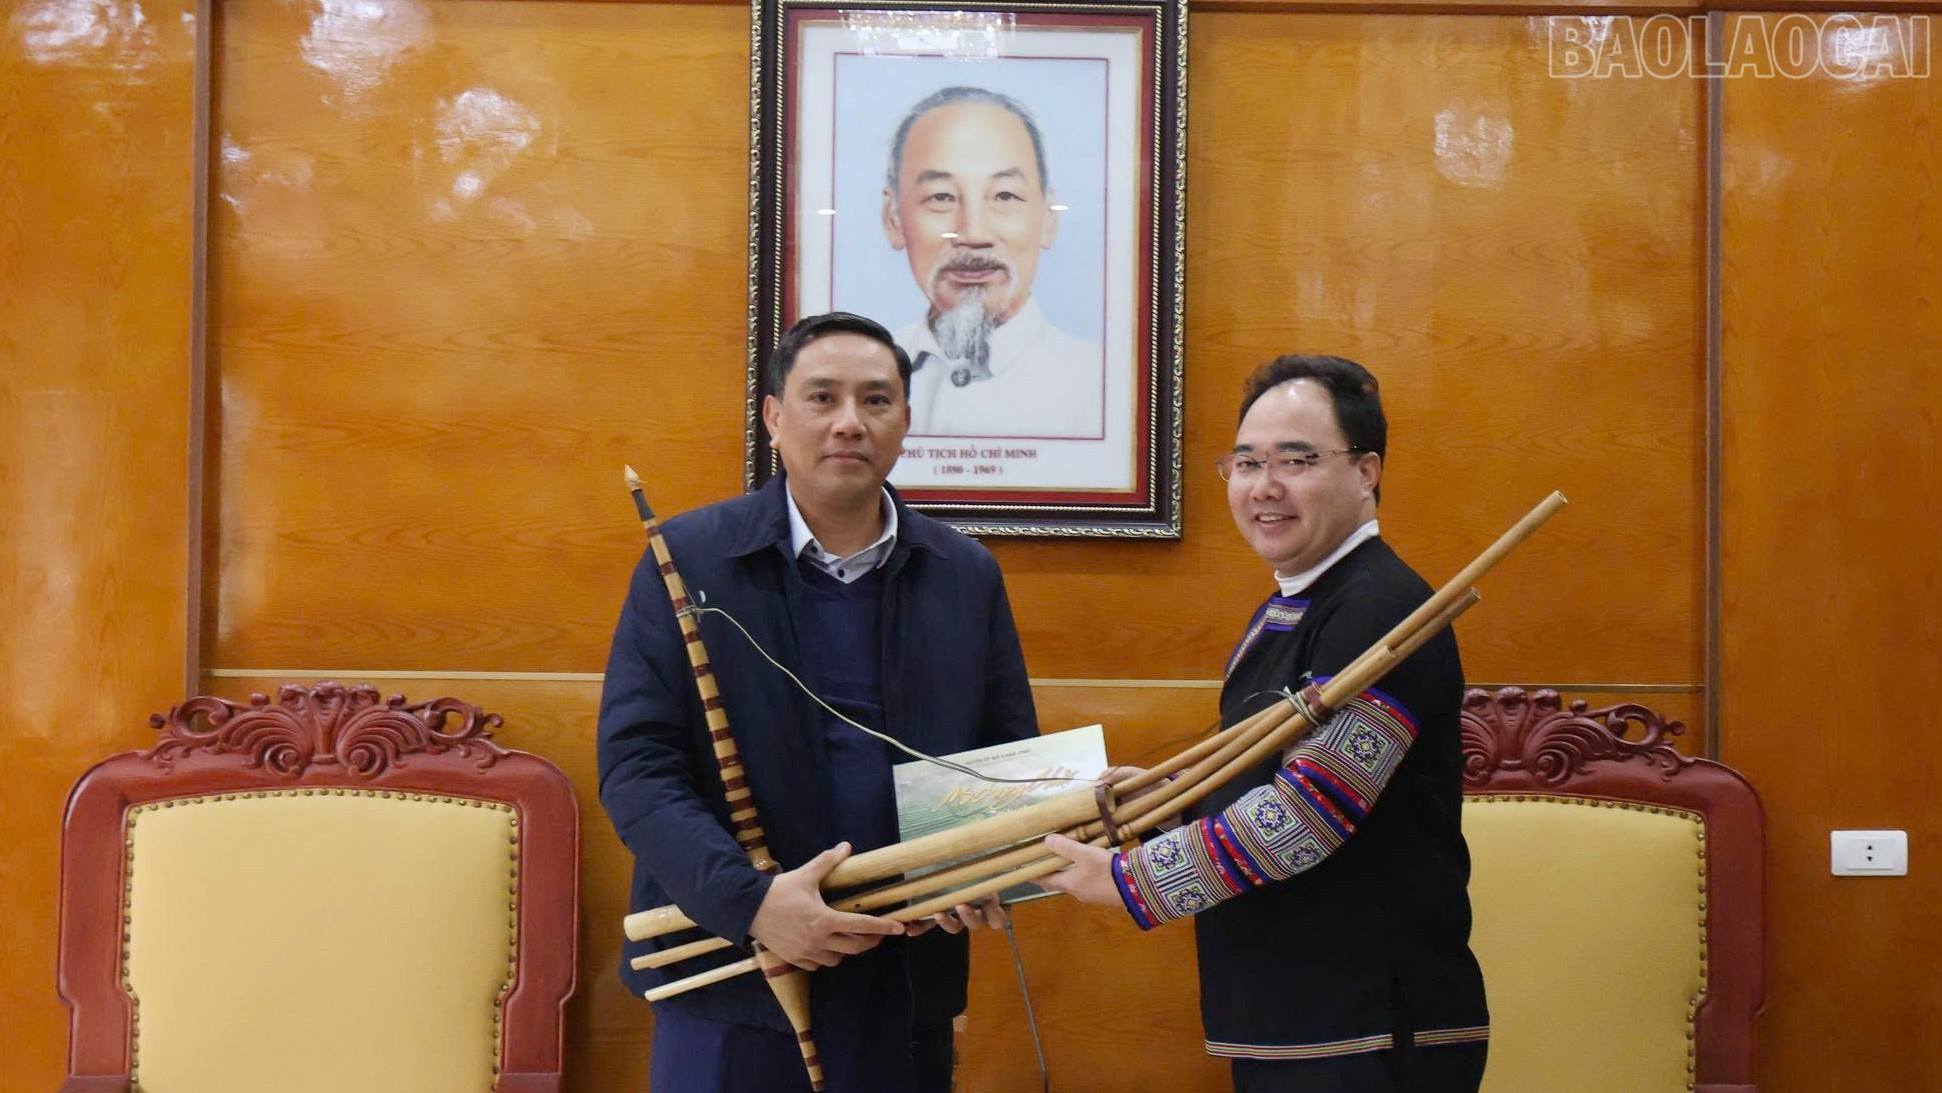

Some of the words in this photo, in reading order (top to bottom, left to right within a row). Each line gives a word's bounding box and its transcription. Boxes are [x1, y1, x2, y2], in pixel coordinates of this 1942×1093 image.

[928, 447, 957, 460] TỊCH
[960, 443, 977, 459] HỒ
[980, 445, 1002, 459] CHÍ
[1005, 448, 1037, 459] MINH
